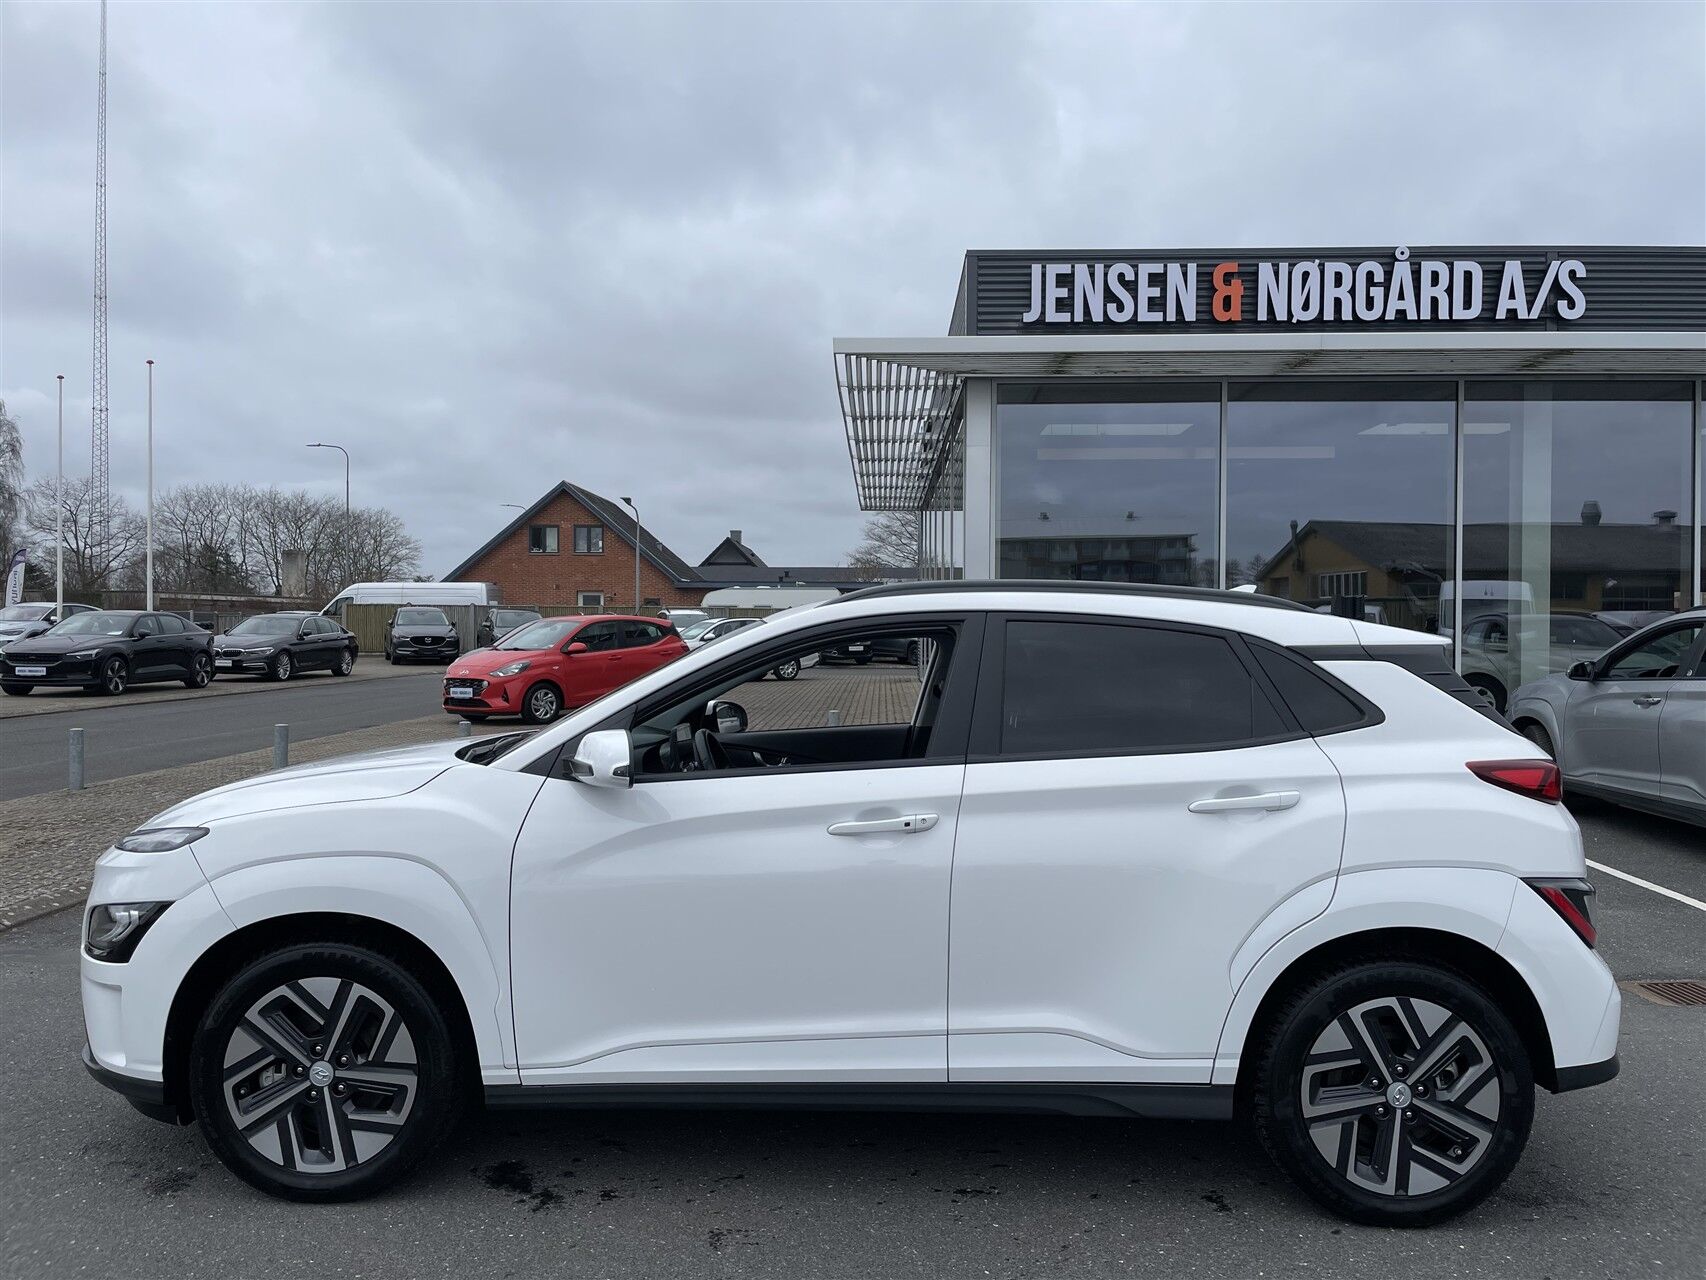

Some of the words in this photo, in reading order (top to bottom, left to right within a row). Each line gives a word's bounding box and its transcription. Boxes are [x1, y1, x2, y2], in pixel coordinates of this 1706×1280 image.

[1022, 262, 1197, 323] JENSEN
[1212, 262, 1244, 322] &
[1257, 246, 1484, 324] NØRGÅRD
[1495, 259, 1587, 320] A/S
